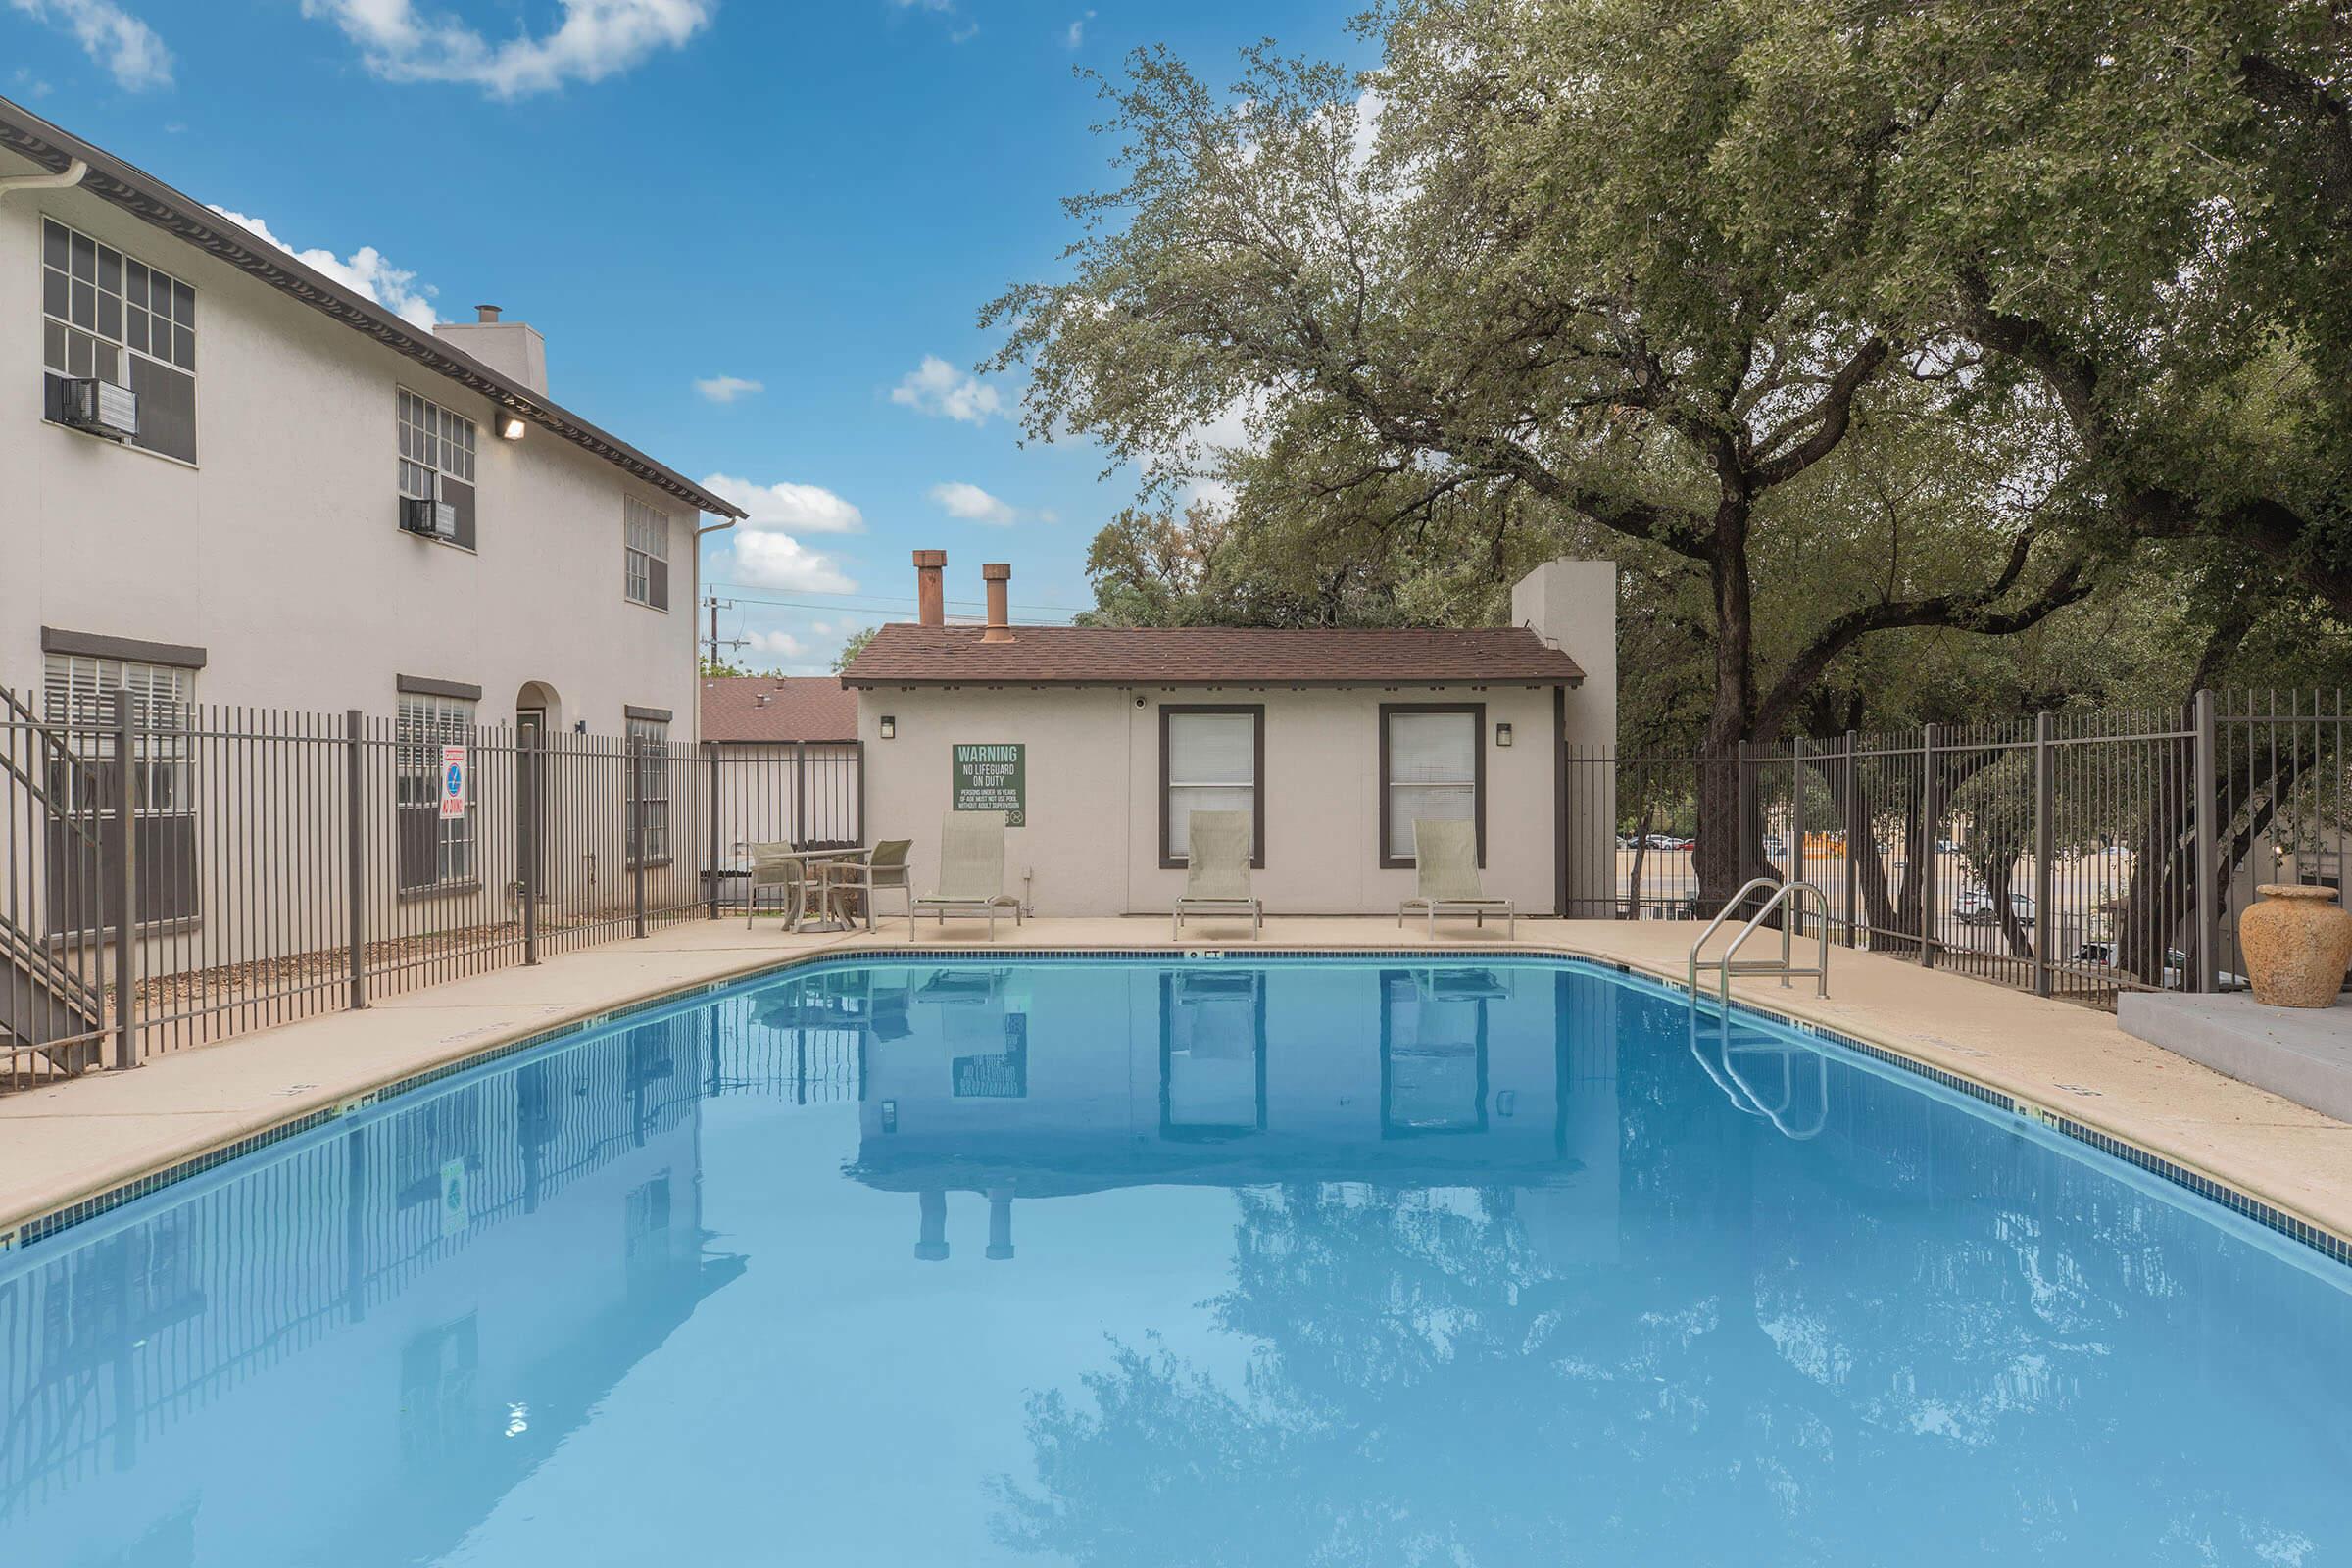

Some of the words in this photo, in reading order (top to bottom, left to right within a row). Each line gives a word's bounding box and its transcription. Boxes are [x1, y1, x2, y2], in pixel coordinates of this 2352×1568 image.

[957, 746, 1017, 762] WARNING
[963, 763, 973, 776] NO
[975, 763, 1015, 776] LIFEGUARD
[973, 775, 983, 787] ON
[985, 775, 1004, 787] DUTY
